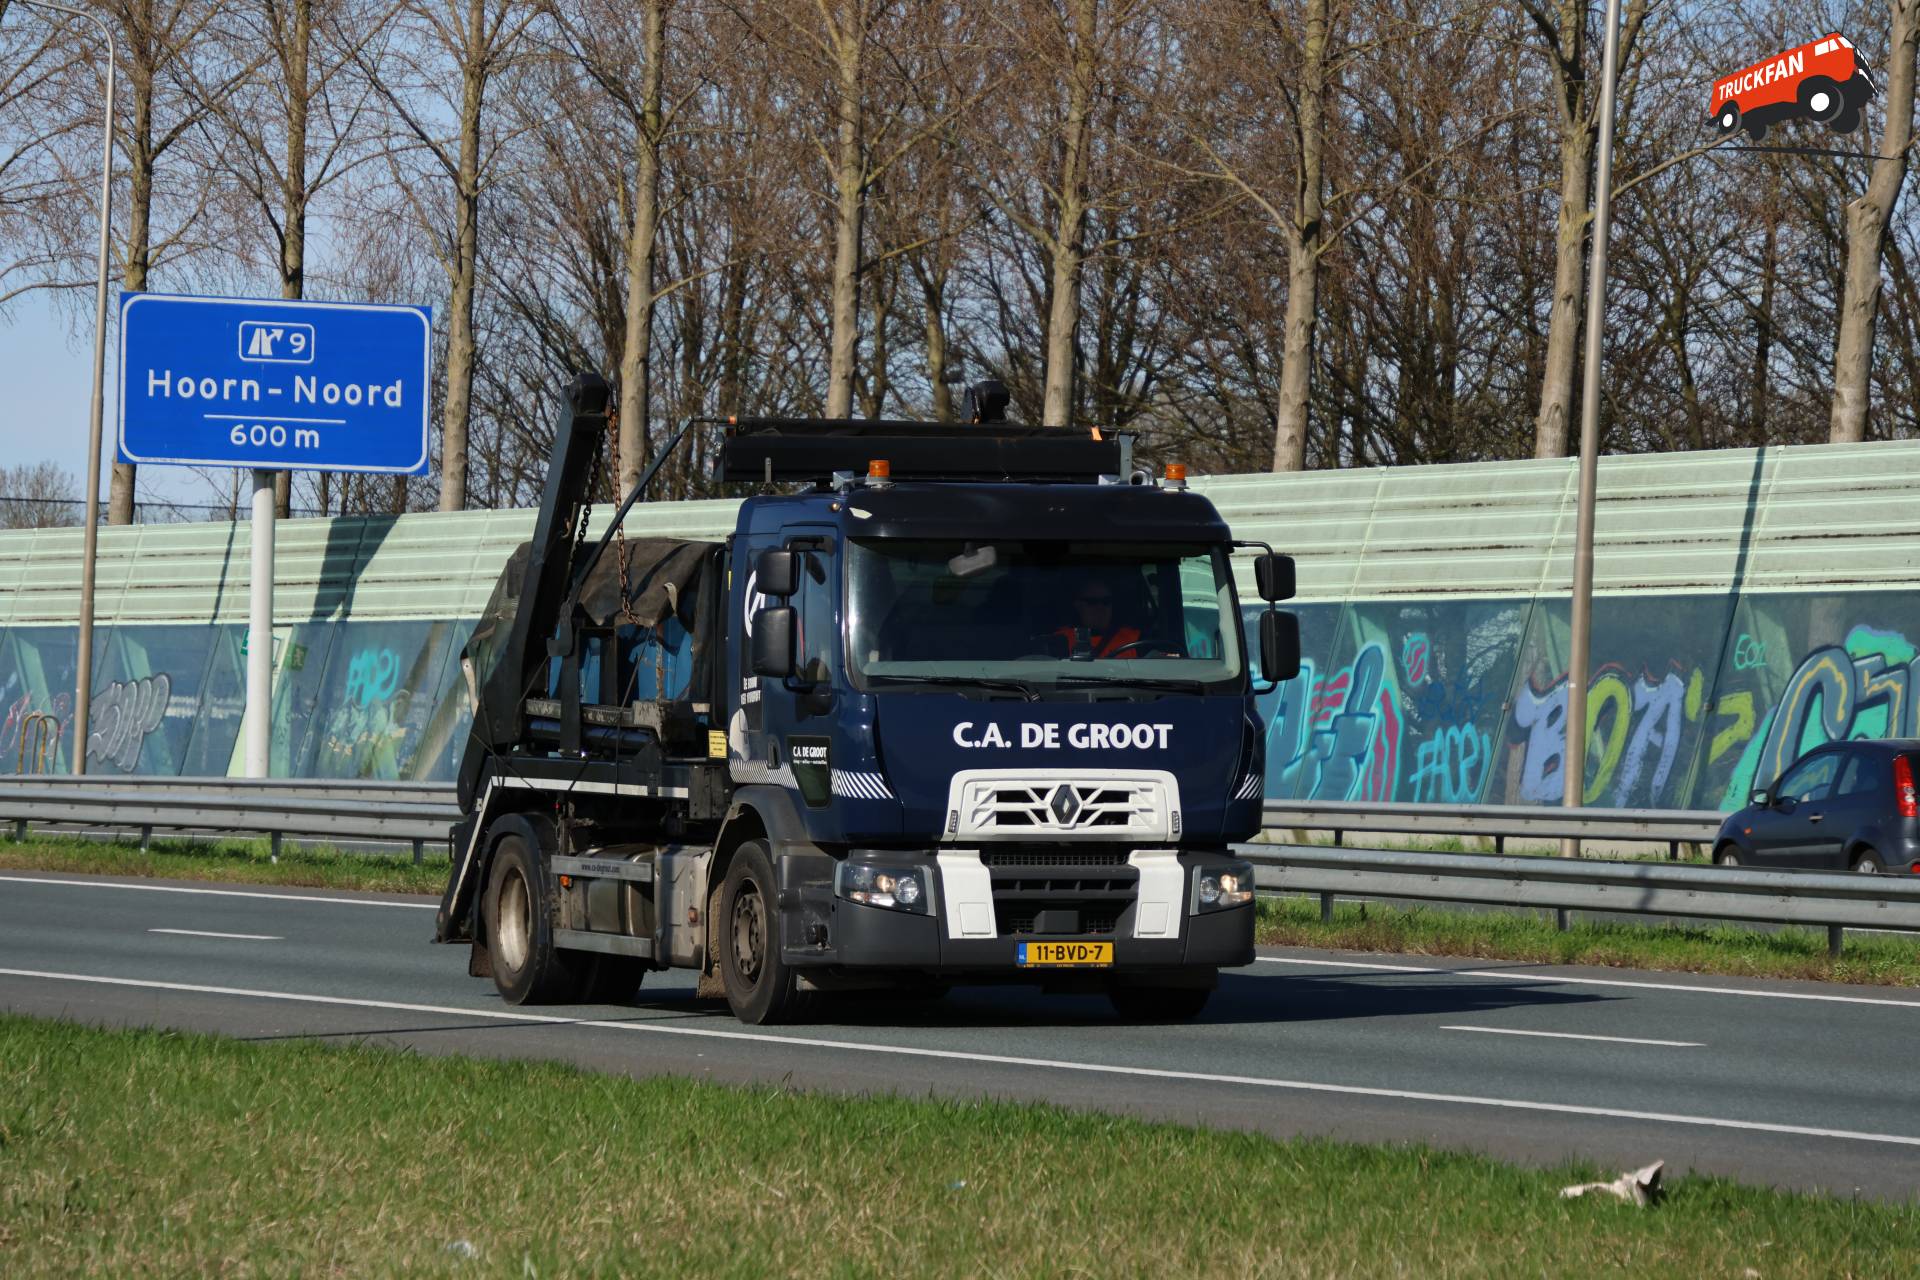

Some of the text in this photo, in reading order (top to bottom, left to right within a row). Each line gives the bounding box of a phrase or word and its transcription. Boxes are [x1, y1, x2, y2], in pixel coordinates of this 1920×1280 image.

[289, 332, 306, 354] 9
[230, 424, 320, 448] 600 m
[952, 722, 1174, 749] C.A. DE GROOT
[1037, 945, 1103, 961] 11-BVD-7
